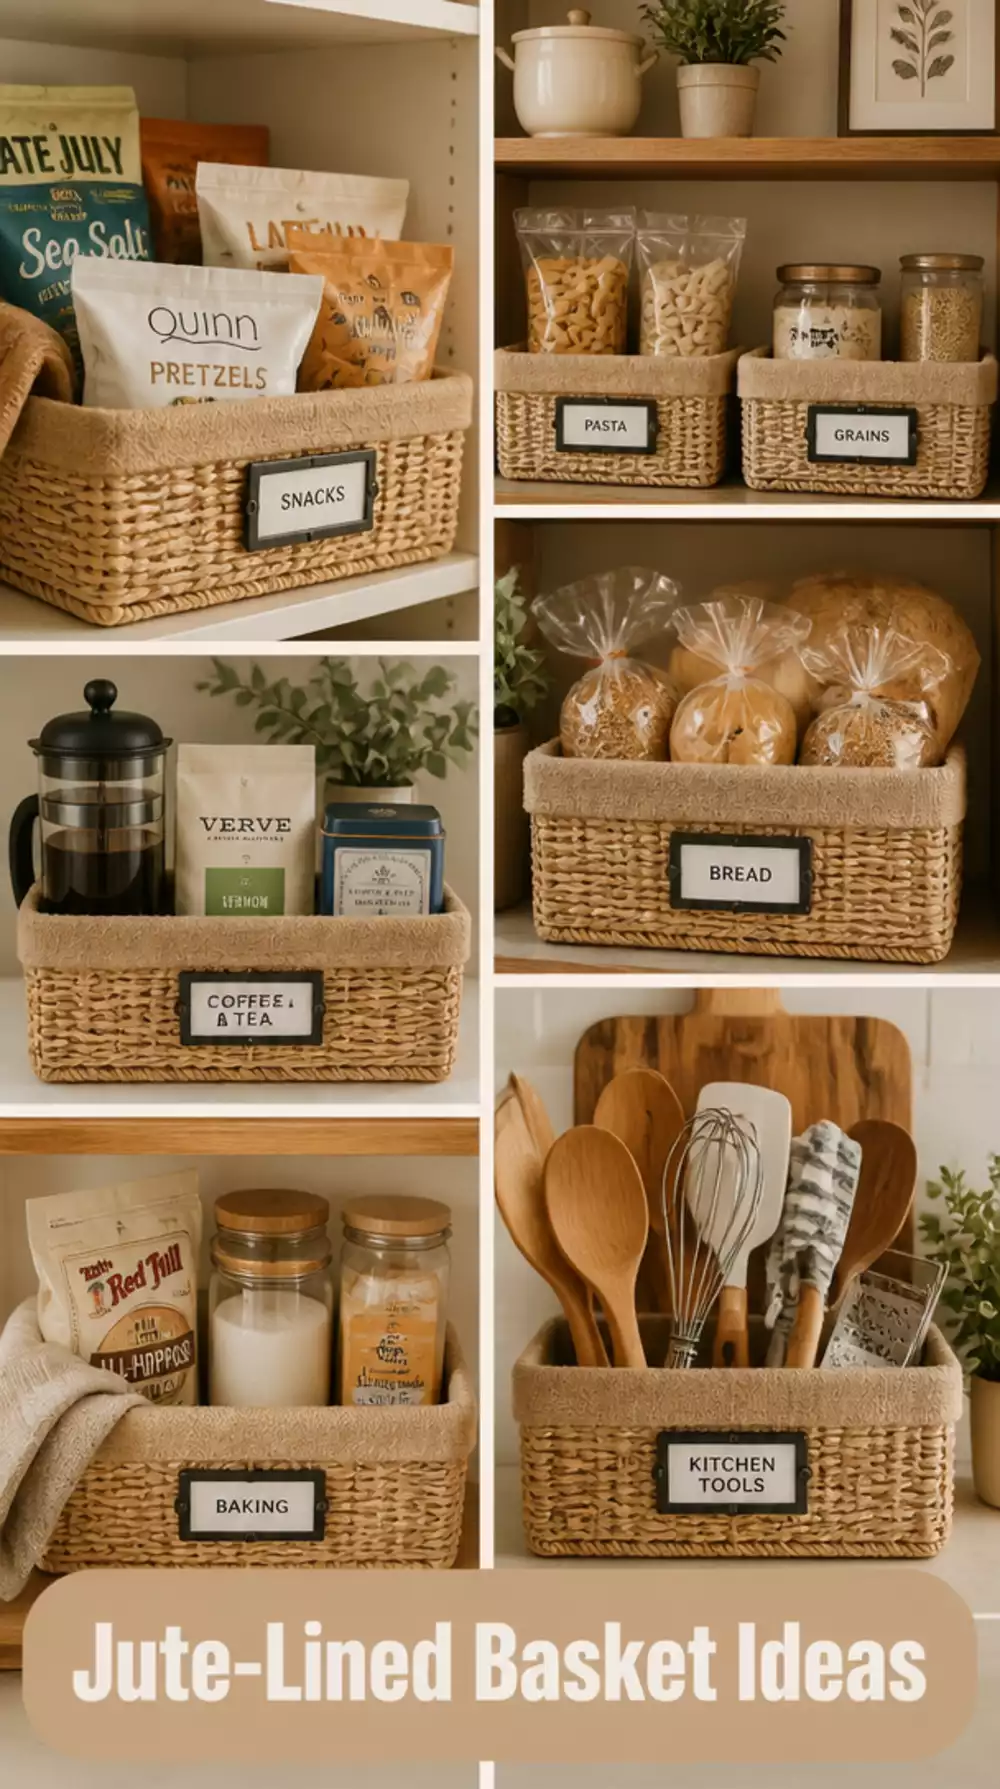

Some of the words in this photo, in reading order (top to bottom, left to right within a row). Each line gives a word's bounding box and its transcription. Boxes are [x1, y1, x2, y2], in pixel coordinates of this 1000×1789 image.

[58, 134, 124, 175] JULY
[19, 227, 80, 279] Sea
[150, 361, 268, 390] PRETZELS
[584, 419, 627, 432] PASTA
[834, 428, 890, 443] GRAINS
[280, 485, 345, 511] SNACKS
[199, 816, 292, 833] VERVE
[709, 865, 773, 882] BREAD
[233, 1012, 273, 1027] TEA
[106, 1260, 148, 1307] Red
[689, 1456, 775, 1472] KITCHEN
[698, 1477, 765, 1493] TOOLS
[216, 1499, 289, 1514] BAKING
